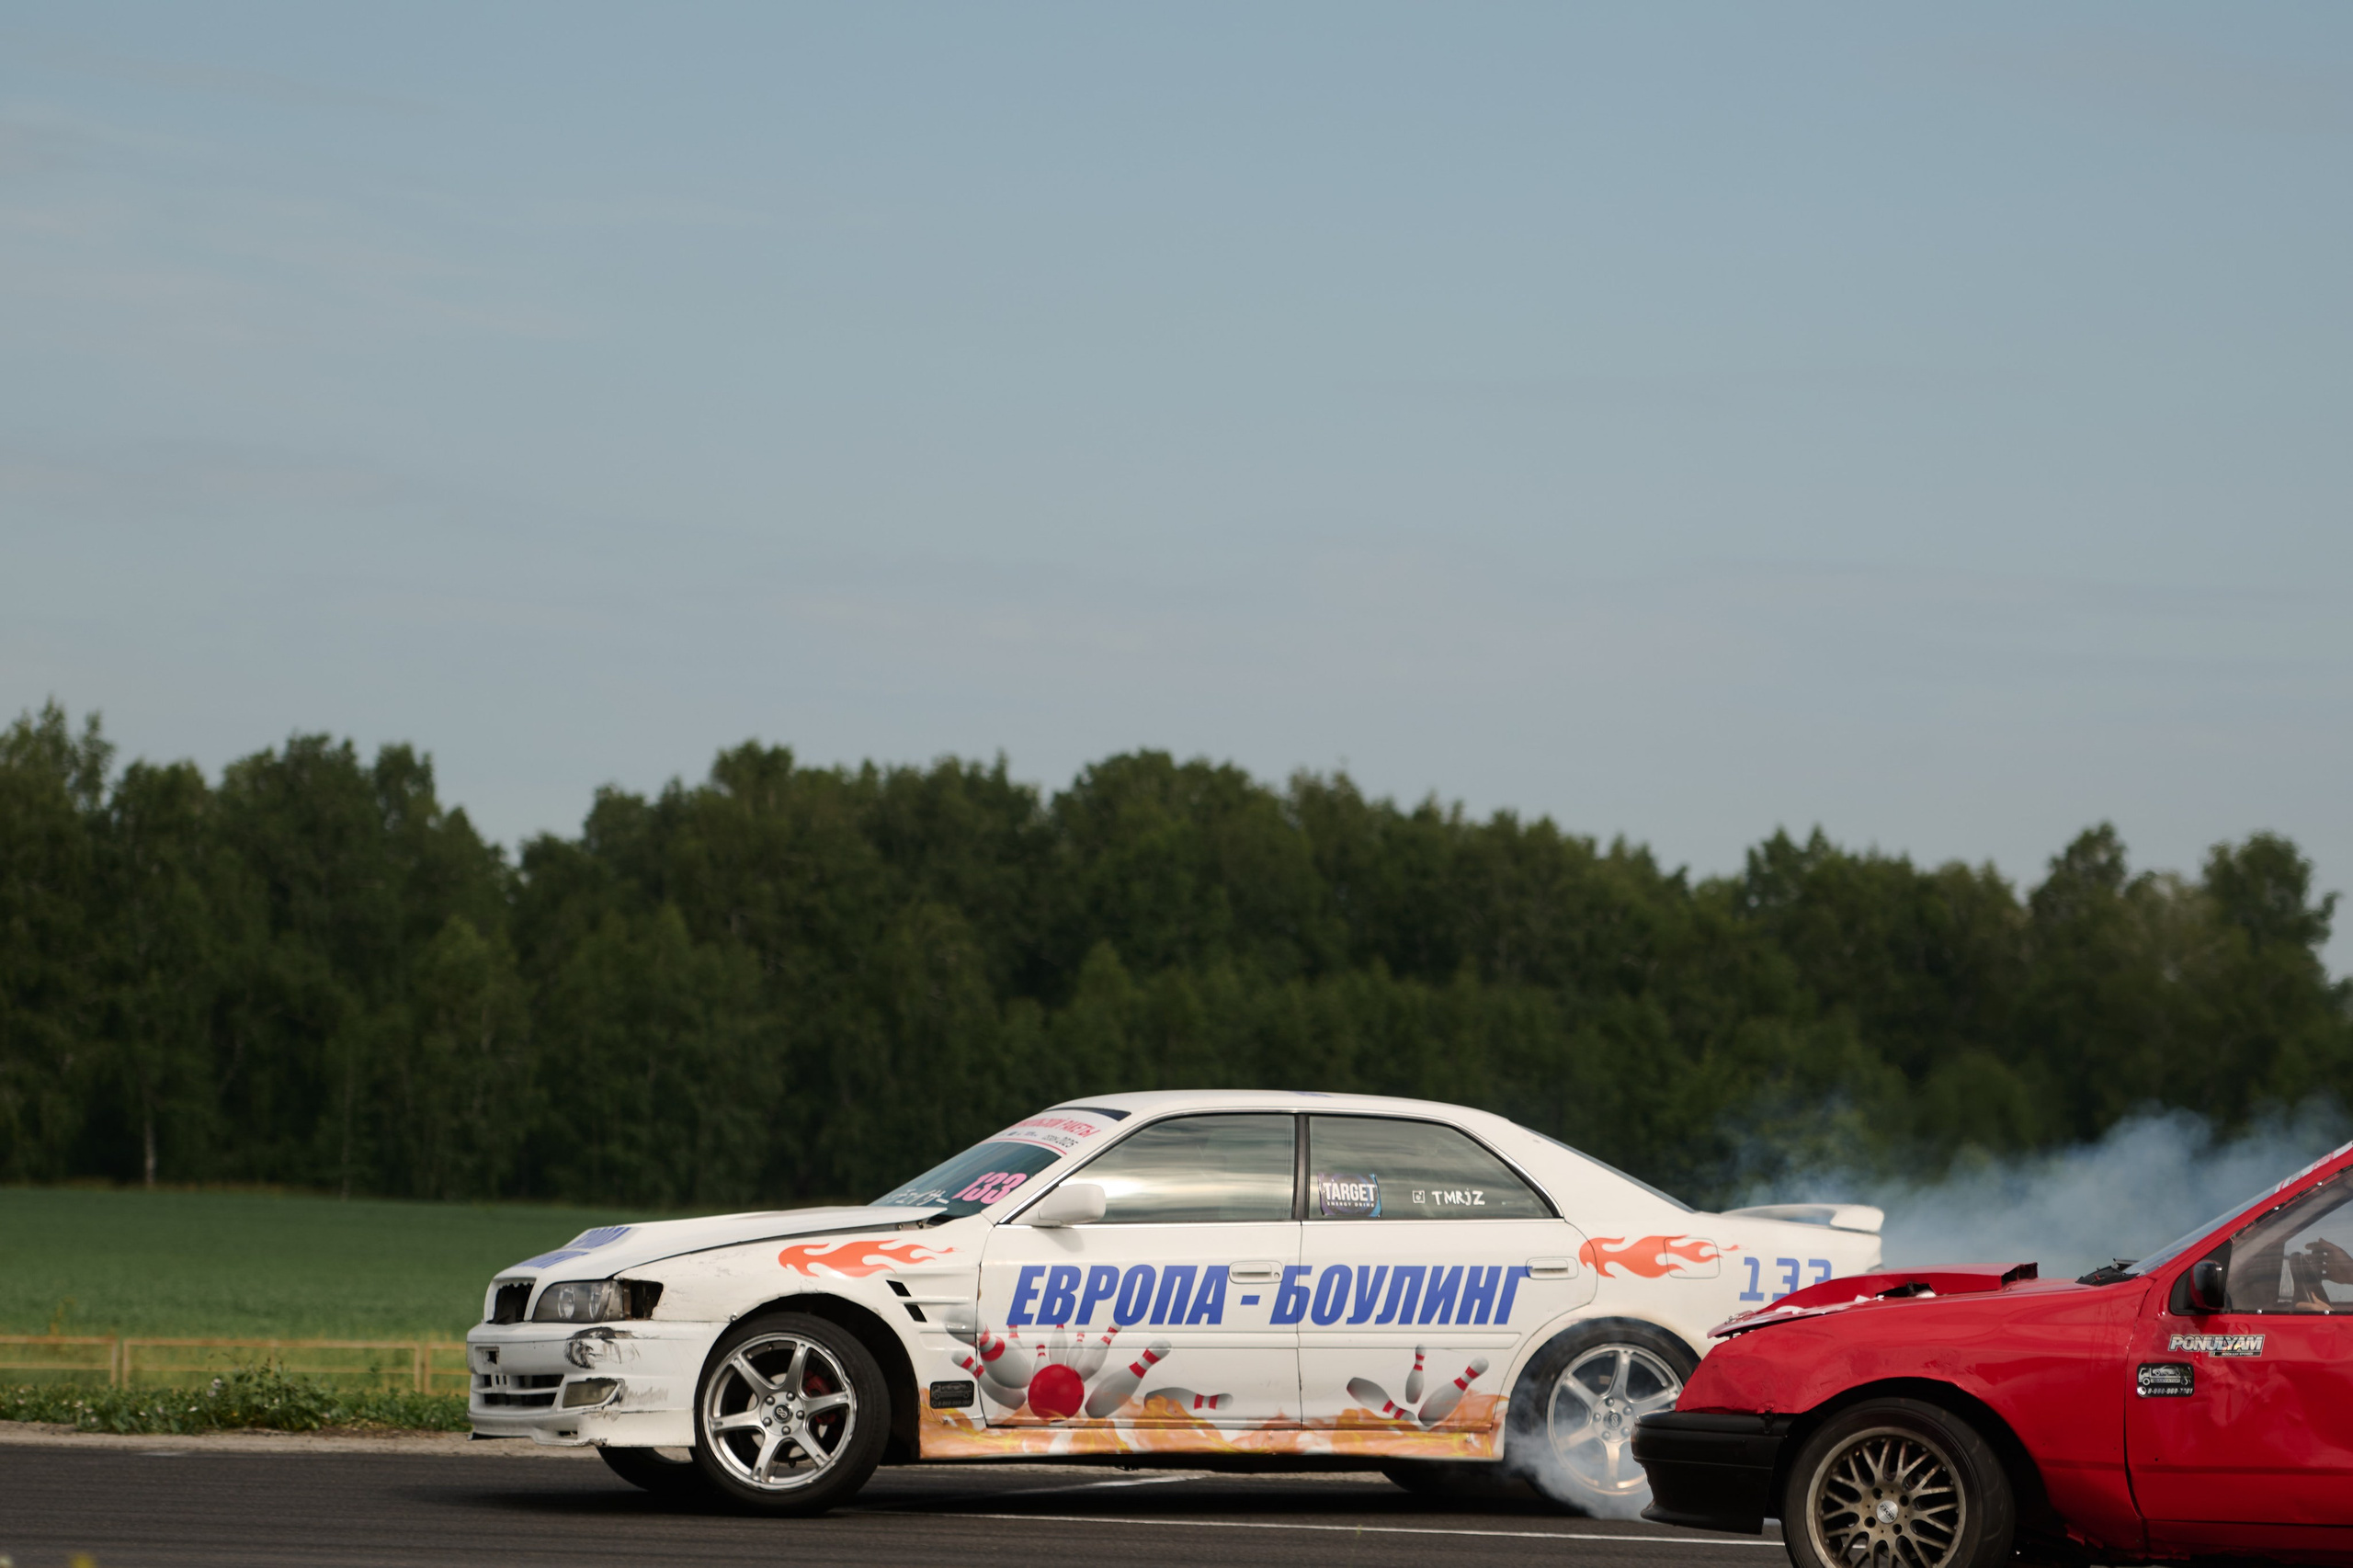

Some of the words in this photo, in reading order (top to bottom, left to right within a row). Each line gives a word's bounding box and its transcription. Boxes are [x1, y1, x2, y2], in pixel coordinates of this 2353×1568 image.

[951, 1172, 1028, 1204] 133
[1323, 1182, 1376, 1202] TARGET
[1739, 1256, 1832, 1301] 133
[1006, 1265, 1229, 1326] ЕВРОПА
[1269, 1265, 1533, 1326] БОУЛИНГ
[2169, 1335, 2264, 1351] PONULYAM
